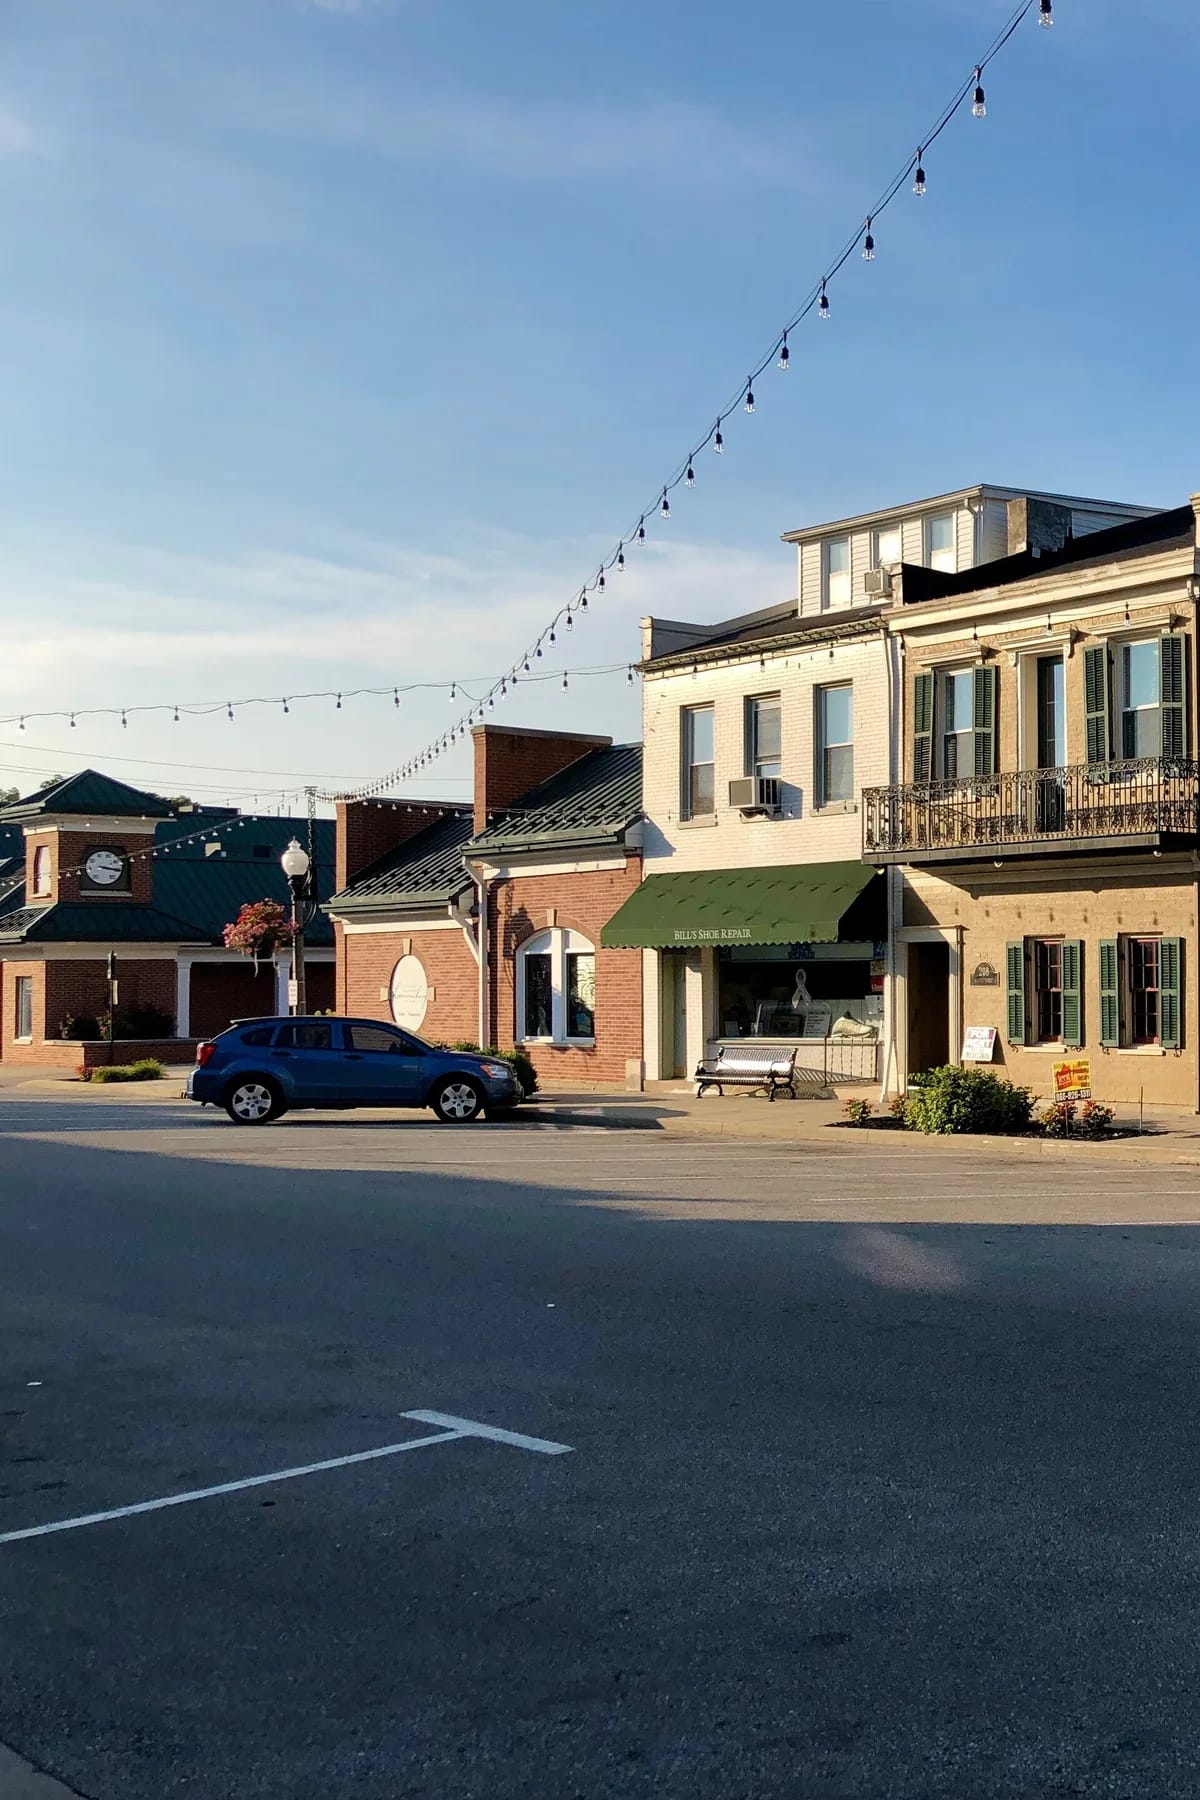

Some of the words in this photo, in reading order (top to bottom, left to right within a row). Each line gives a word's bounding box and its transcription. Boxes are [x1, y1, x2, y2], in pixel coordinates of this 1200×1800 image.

[698, 929, 720, 939] SHOE
[721, 928, 752, 939] REPAIR
[970, 1029, 989, 1039] FOR
[965, 1039, 992, 1048] RENT
